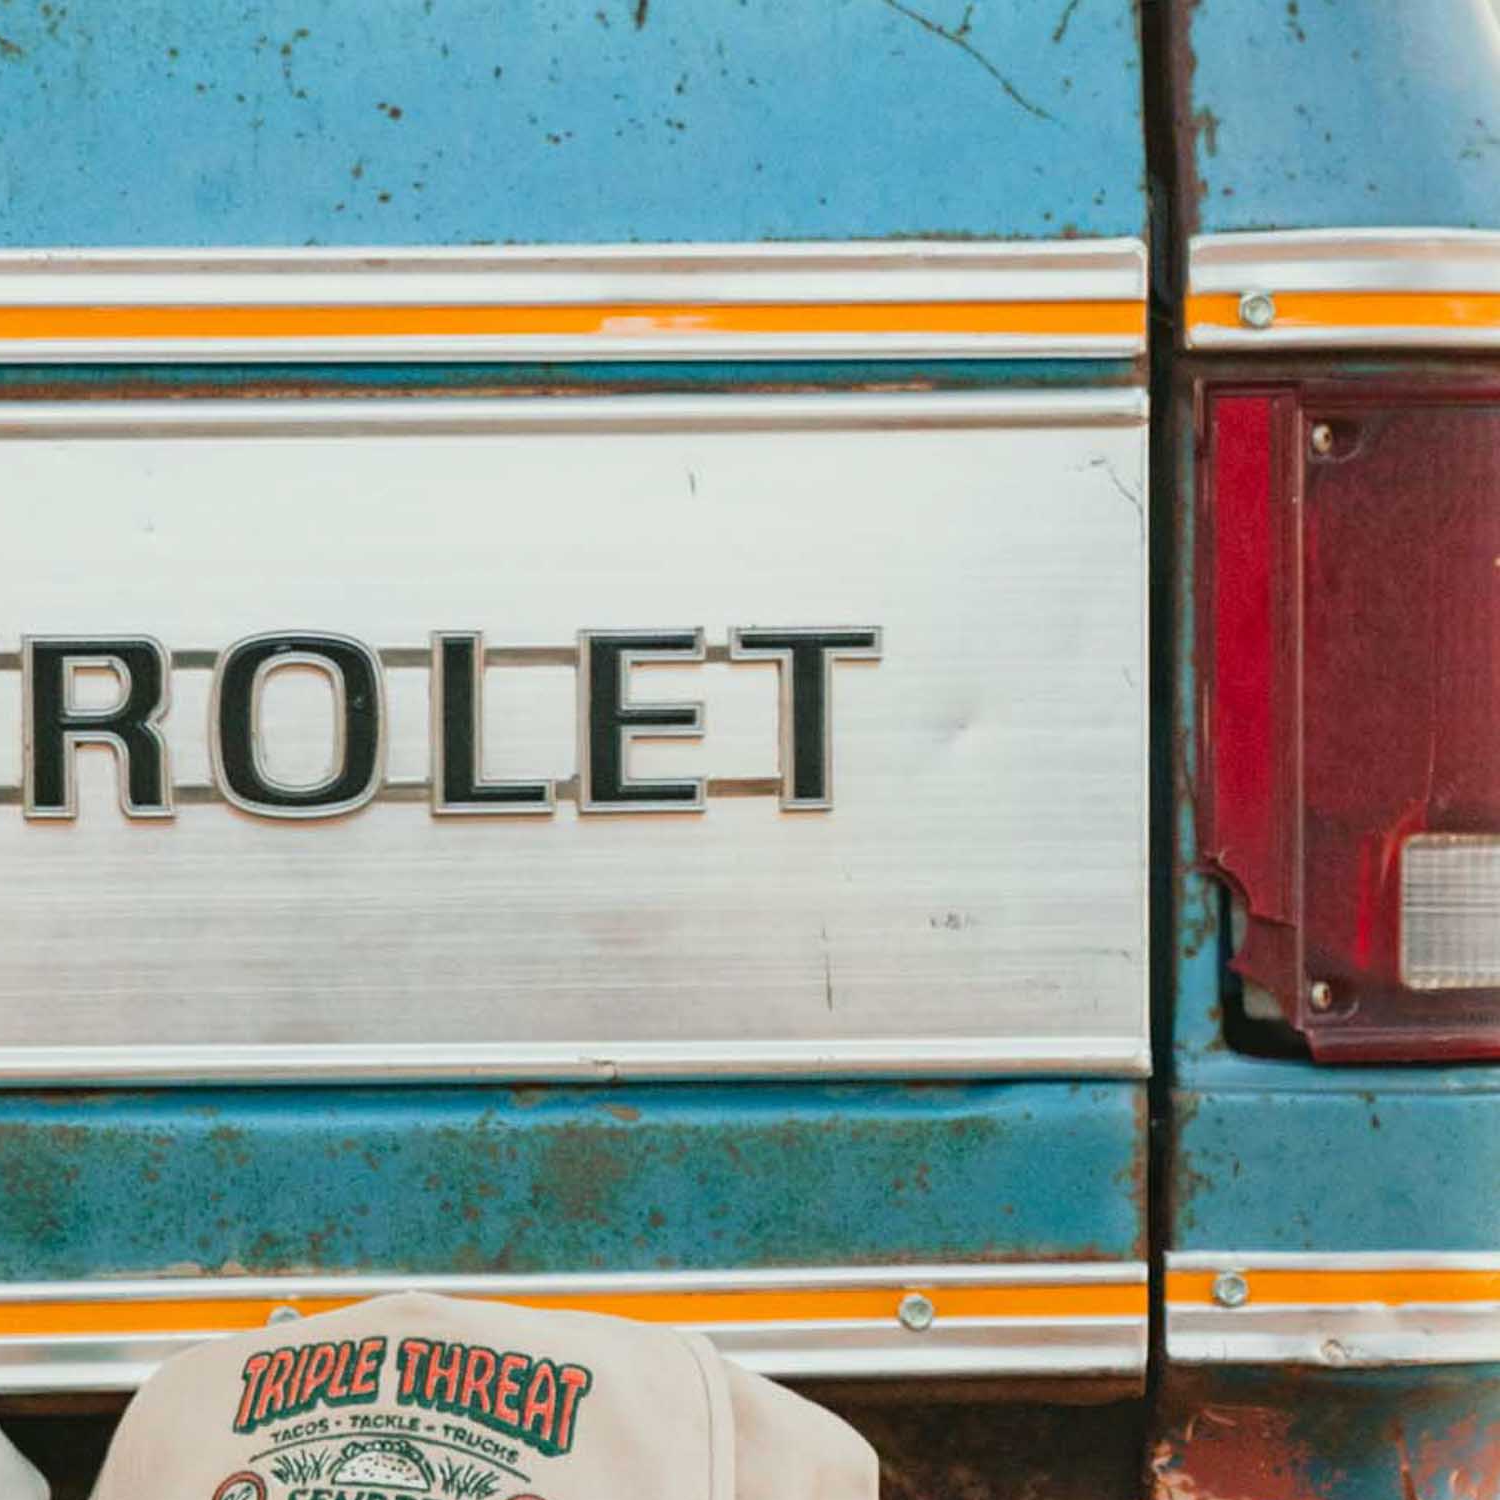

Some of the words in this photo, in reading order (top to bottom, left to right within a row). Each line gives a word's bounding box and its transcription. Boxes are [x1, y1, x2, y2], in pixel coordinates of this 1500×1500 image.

[233, 1336, 389, 1435] TRIPLE
[398, 1337, 593, 1458] THREAT
[269, 1417, 331, 1444] TACOS
[349, 1414, 420, 1431] TACKLE
[443, 1423, 521, 1464] TRUCKS
